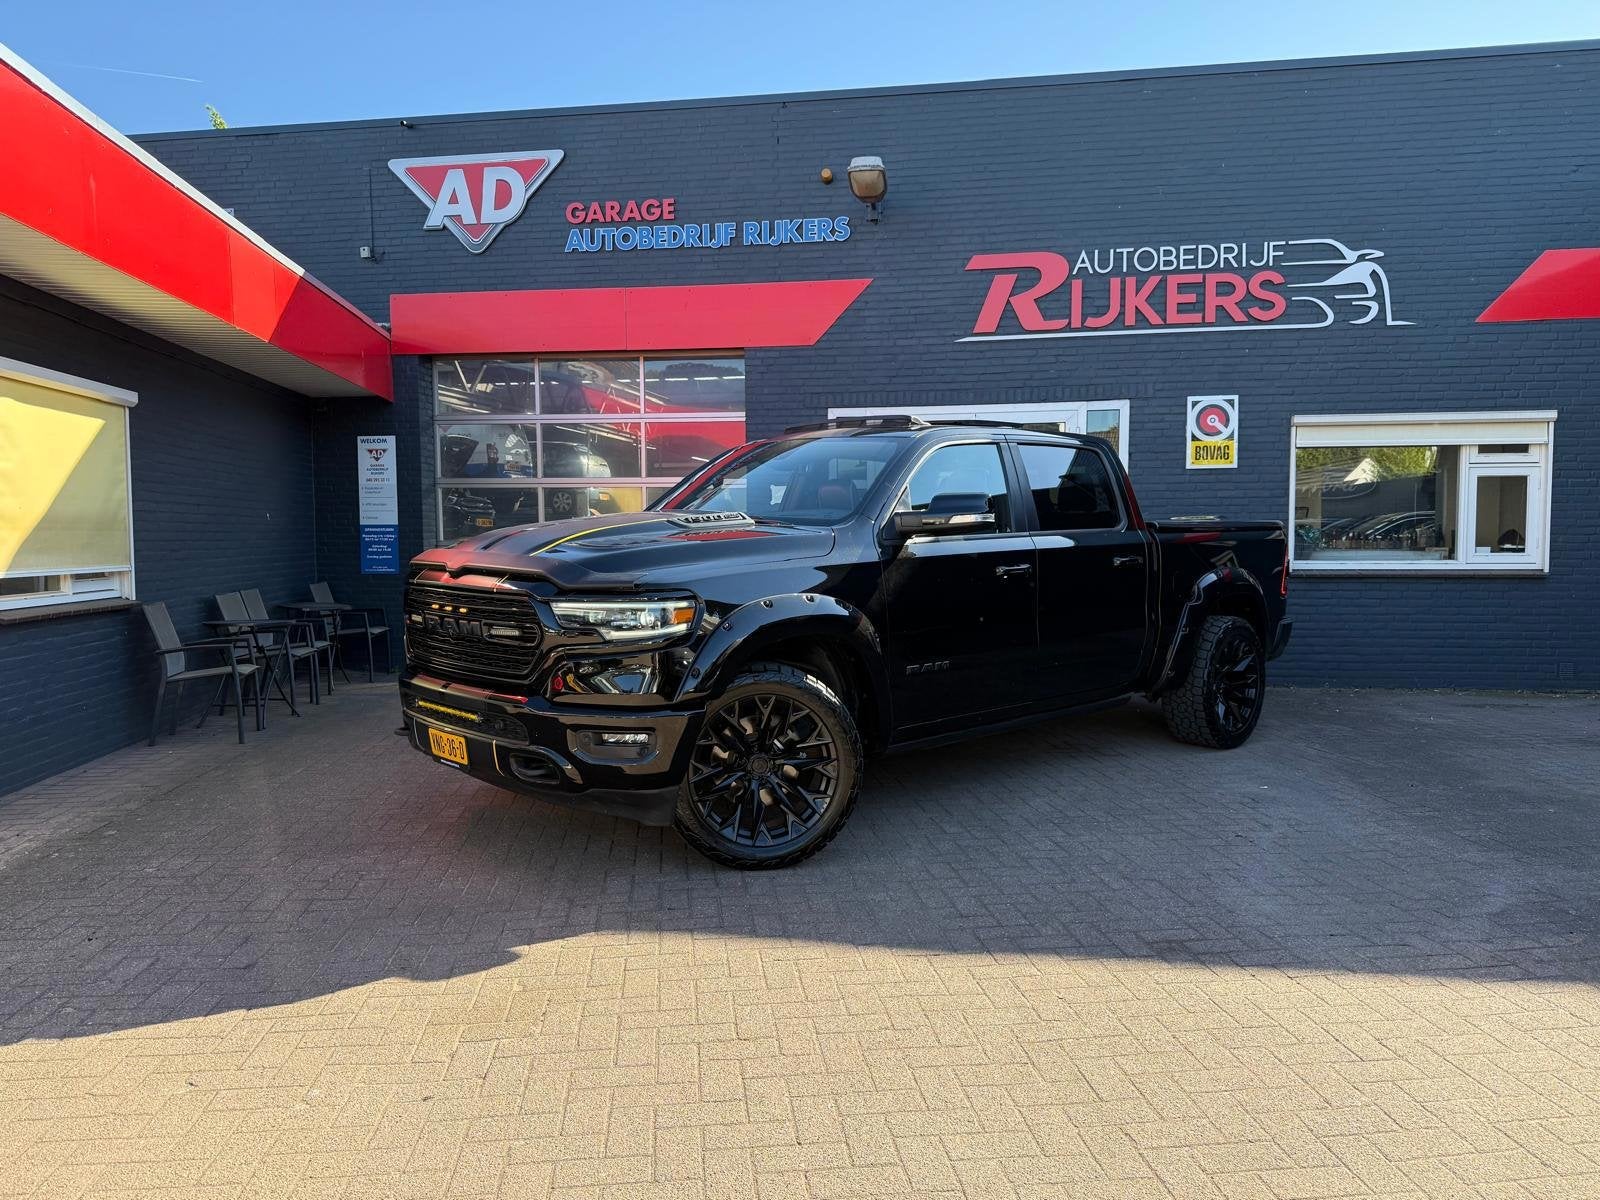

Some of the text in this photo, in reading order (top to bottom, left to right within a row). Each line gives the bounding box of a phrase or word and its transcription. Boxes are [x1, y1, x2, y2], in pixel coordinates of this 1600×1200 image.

[423, 165, 528, 231] AD
[564, 198, 676, 225] GARAGE
[564, 215, 852, 253] AUTOBEDRIJF RIJKERS
[1072, 241, 1287, 275] AUTOBEDRIJF
[964, 250, 1288, 334] RIJKERS
[1195, 444, 1230, 461] BOVAG
[425, 615, 480, 637] RAM
